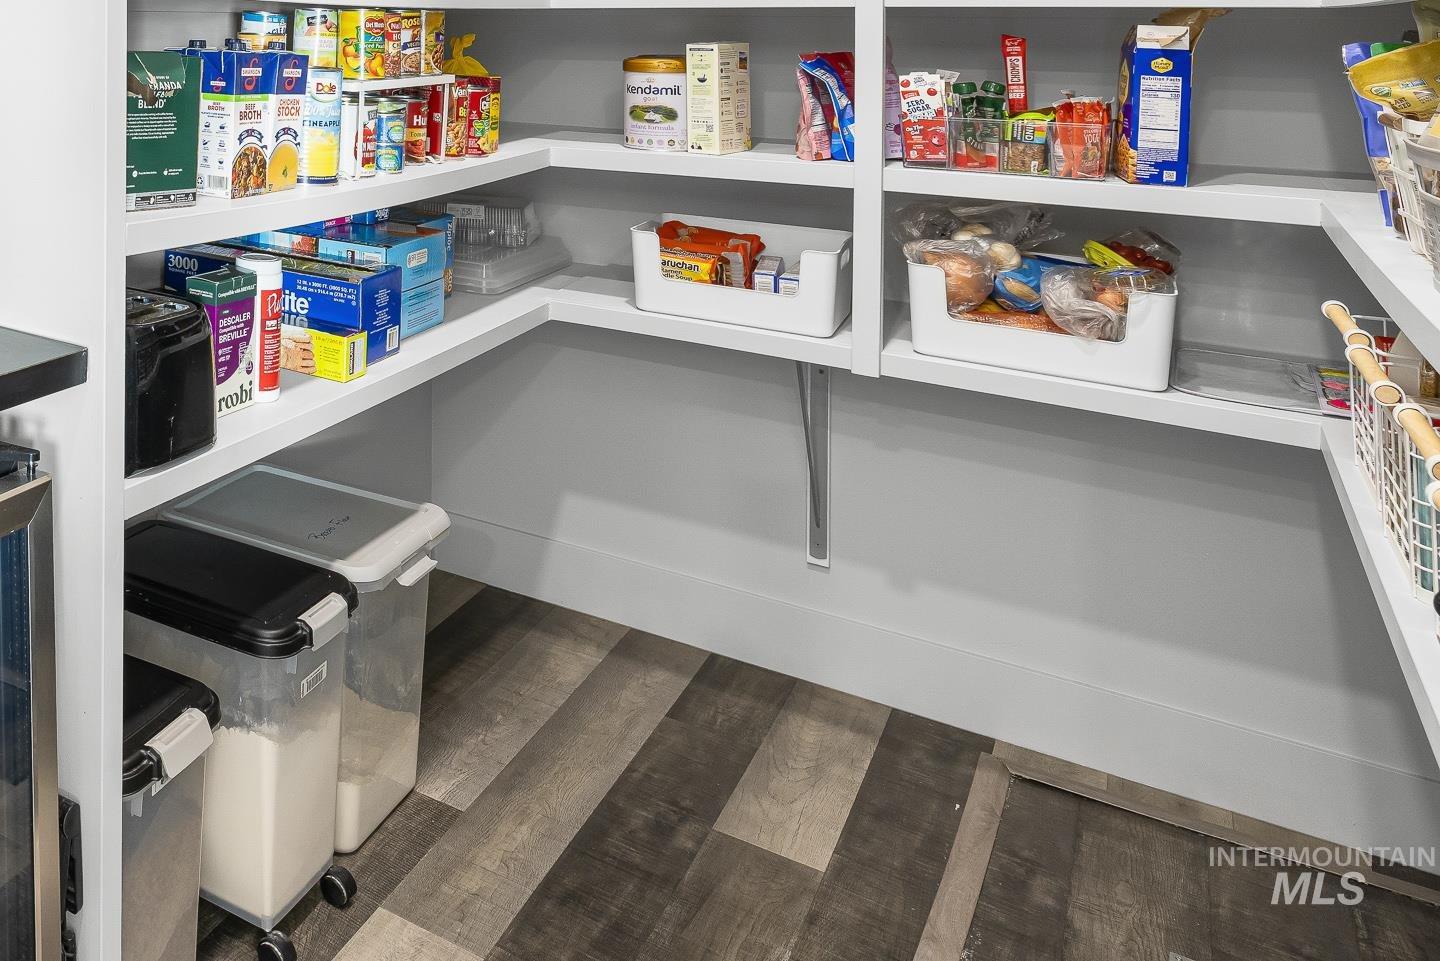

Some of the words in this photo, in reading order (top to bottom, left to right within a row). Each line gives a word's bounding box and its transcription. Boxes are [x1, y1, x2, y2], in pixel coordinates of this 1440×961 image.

[1010, 57, 1020, 83] CHOMPS
[316, 82, 337, 93] Dole
[245, 103, 256, 111] BEEF
[906, 99, 925, 108] ZERO
[906, 103, 932, 115] SUGAR
[239, 110, 262, 121] BROTH
[277, 106, 301, 117] STOCK
[168, 254, 199, 272] 3000
[661, 258, 700, 272] aruchan
[219, 311, 251, 328] DESCALER
[218, 380, 253, 413] roobi
